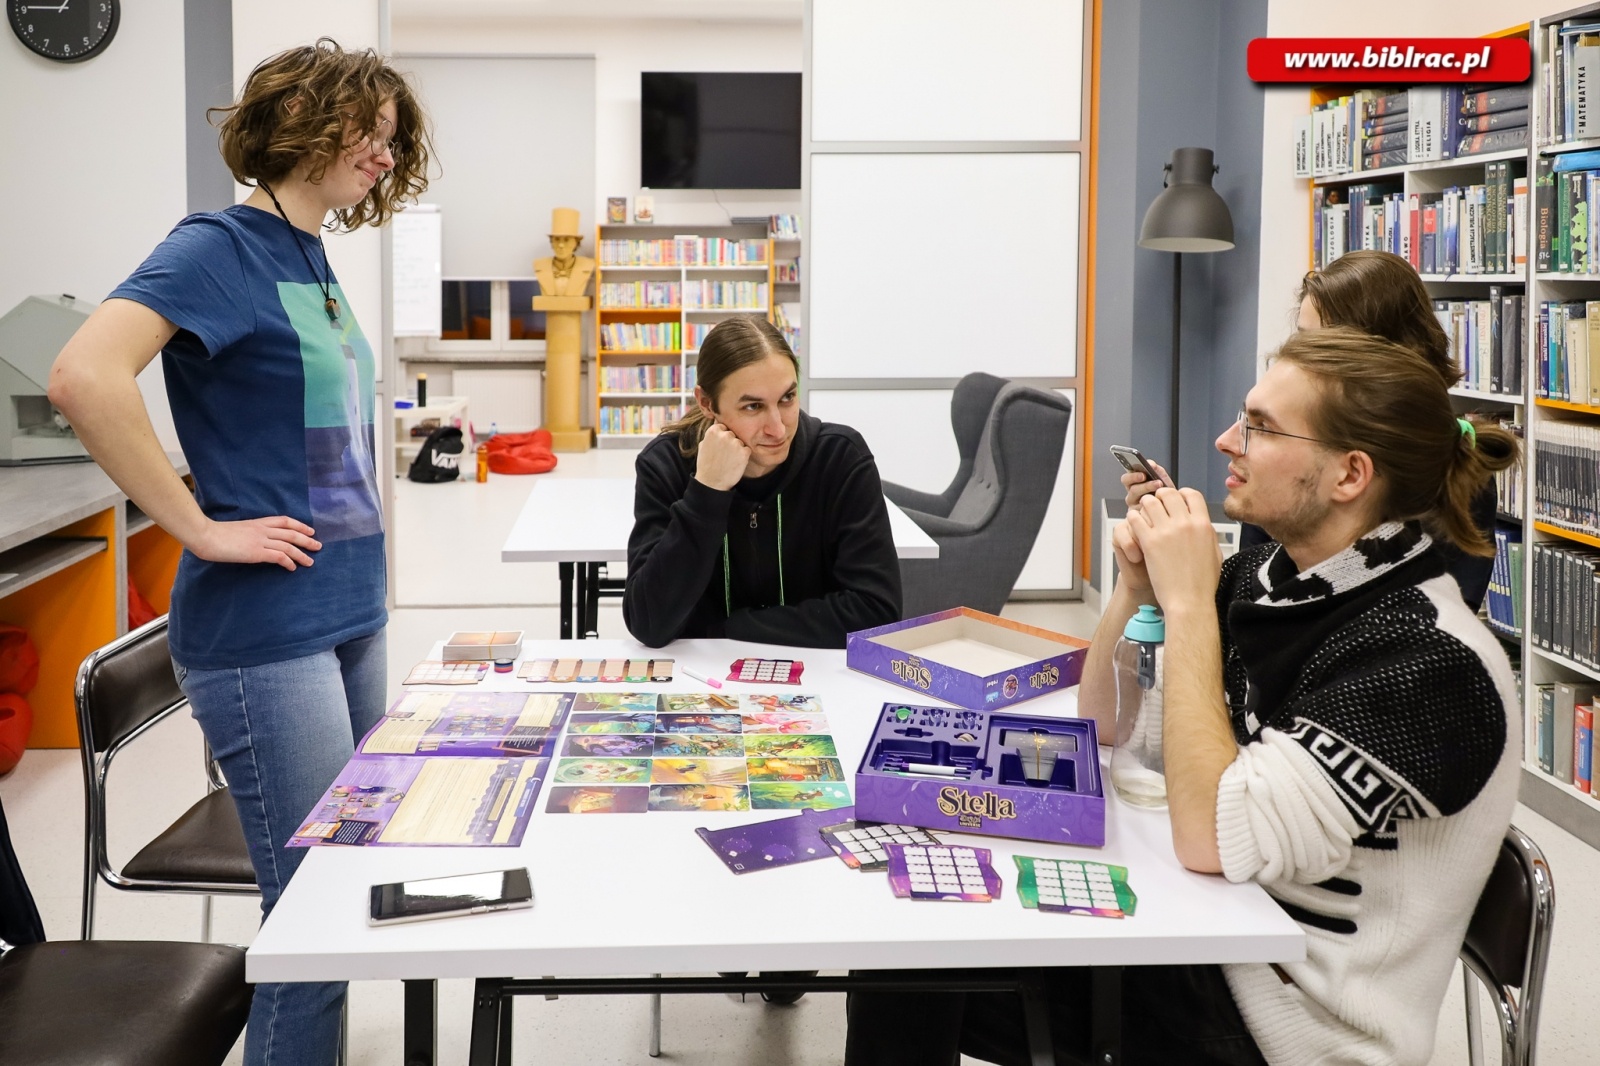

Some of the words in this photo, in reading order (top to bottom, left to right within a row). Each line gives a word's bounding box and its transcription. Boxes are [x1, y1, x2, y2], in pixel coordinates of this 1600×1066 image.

[21, 6, 28, 14] 9
[100, 4, 106, 12] 3
[28, 24, 34, 33] 8
[97, 22, 103, 30] 4
[44, 39, 50, 48] 7
[83, 37, 90, 46] 5
[64, 44, 70, 53] 6
[1539, 207, 1549, 249] Biologia
[431, 448, 461, 469] VAN
[891, 660, 932, 690] Stella
[1029, 666, 1059, 689] Stella
[936, 786, 1016, 820] Stella
